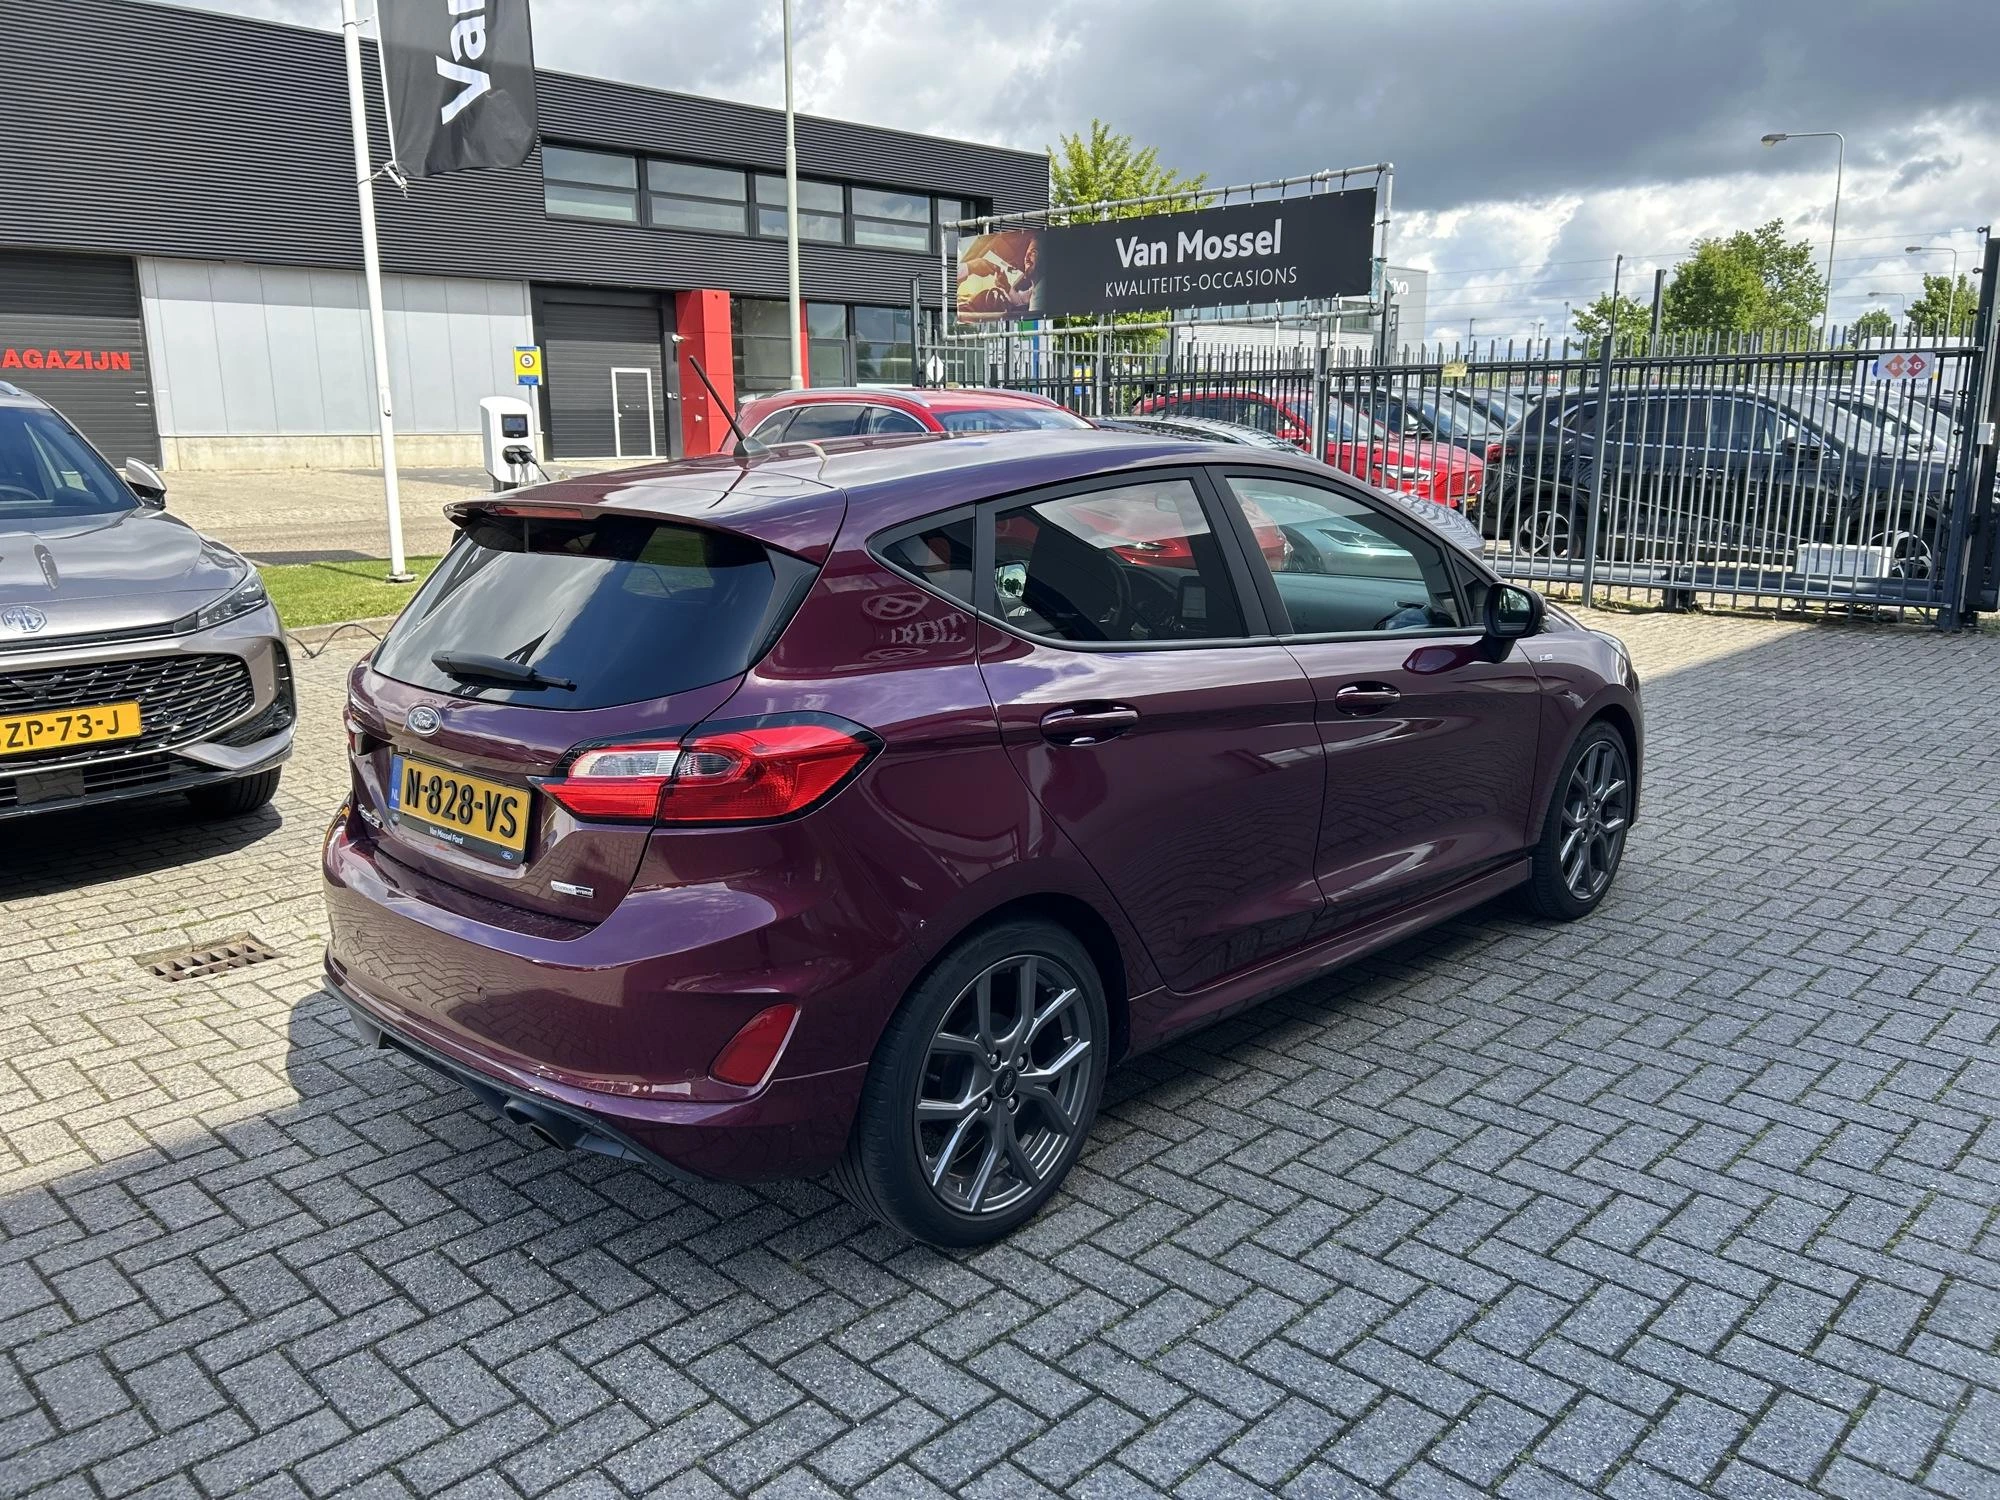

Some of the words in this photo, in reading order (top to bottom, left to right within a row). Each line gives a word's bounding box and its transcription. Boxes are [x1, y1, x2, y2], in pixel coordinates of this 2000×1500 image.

[1115, 235, 1168, 268] Van
[1176, 218, 1283, 263] Mossel
[1104, 266, 1298, 298] KWALITEITS-OCCASIONS
[0, 348, 131, 371] AGAZIJN
[524, 357, 531, 365] 5
[4, 608, 44, 631] MG
[0, 710, 120, 748] ZP-73-J
[391, 788, 400, 801] NL
[405, 767, 518, 838] N-828-VS
[452, 833, 464, 845] Ford
